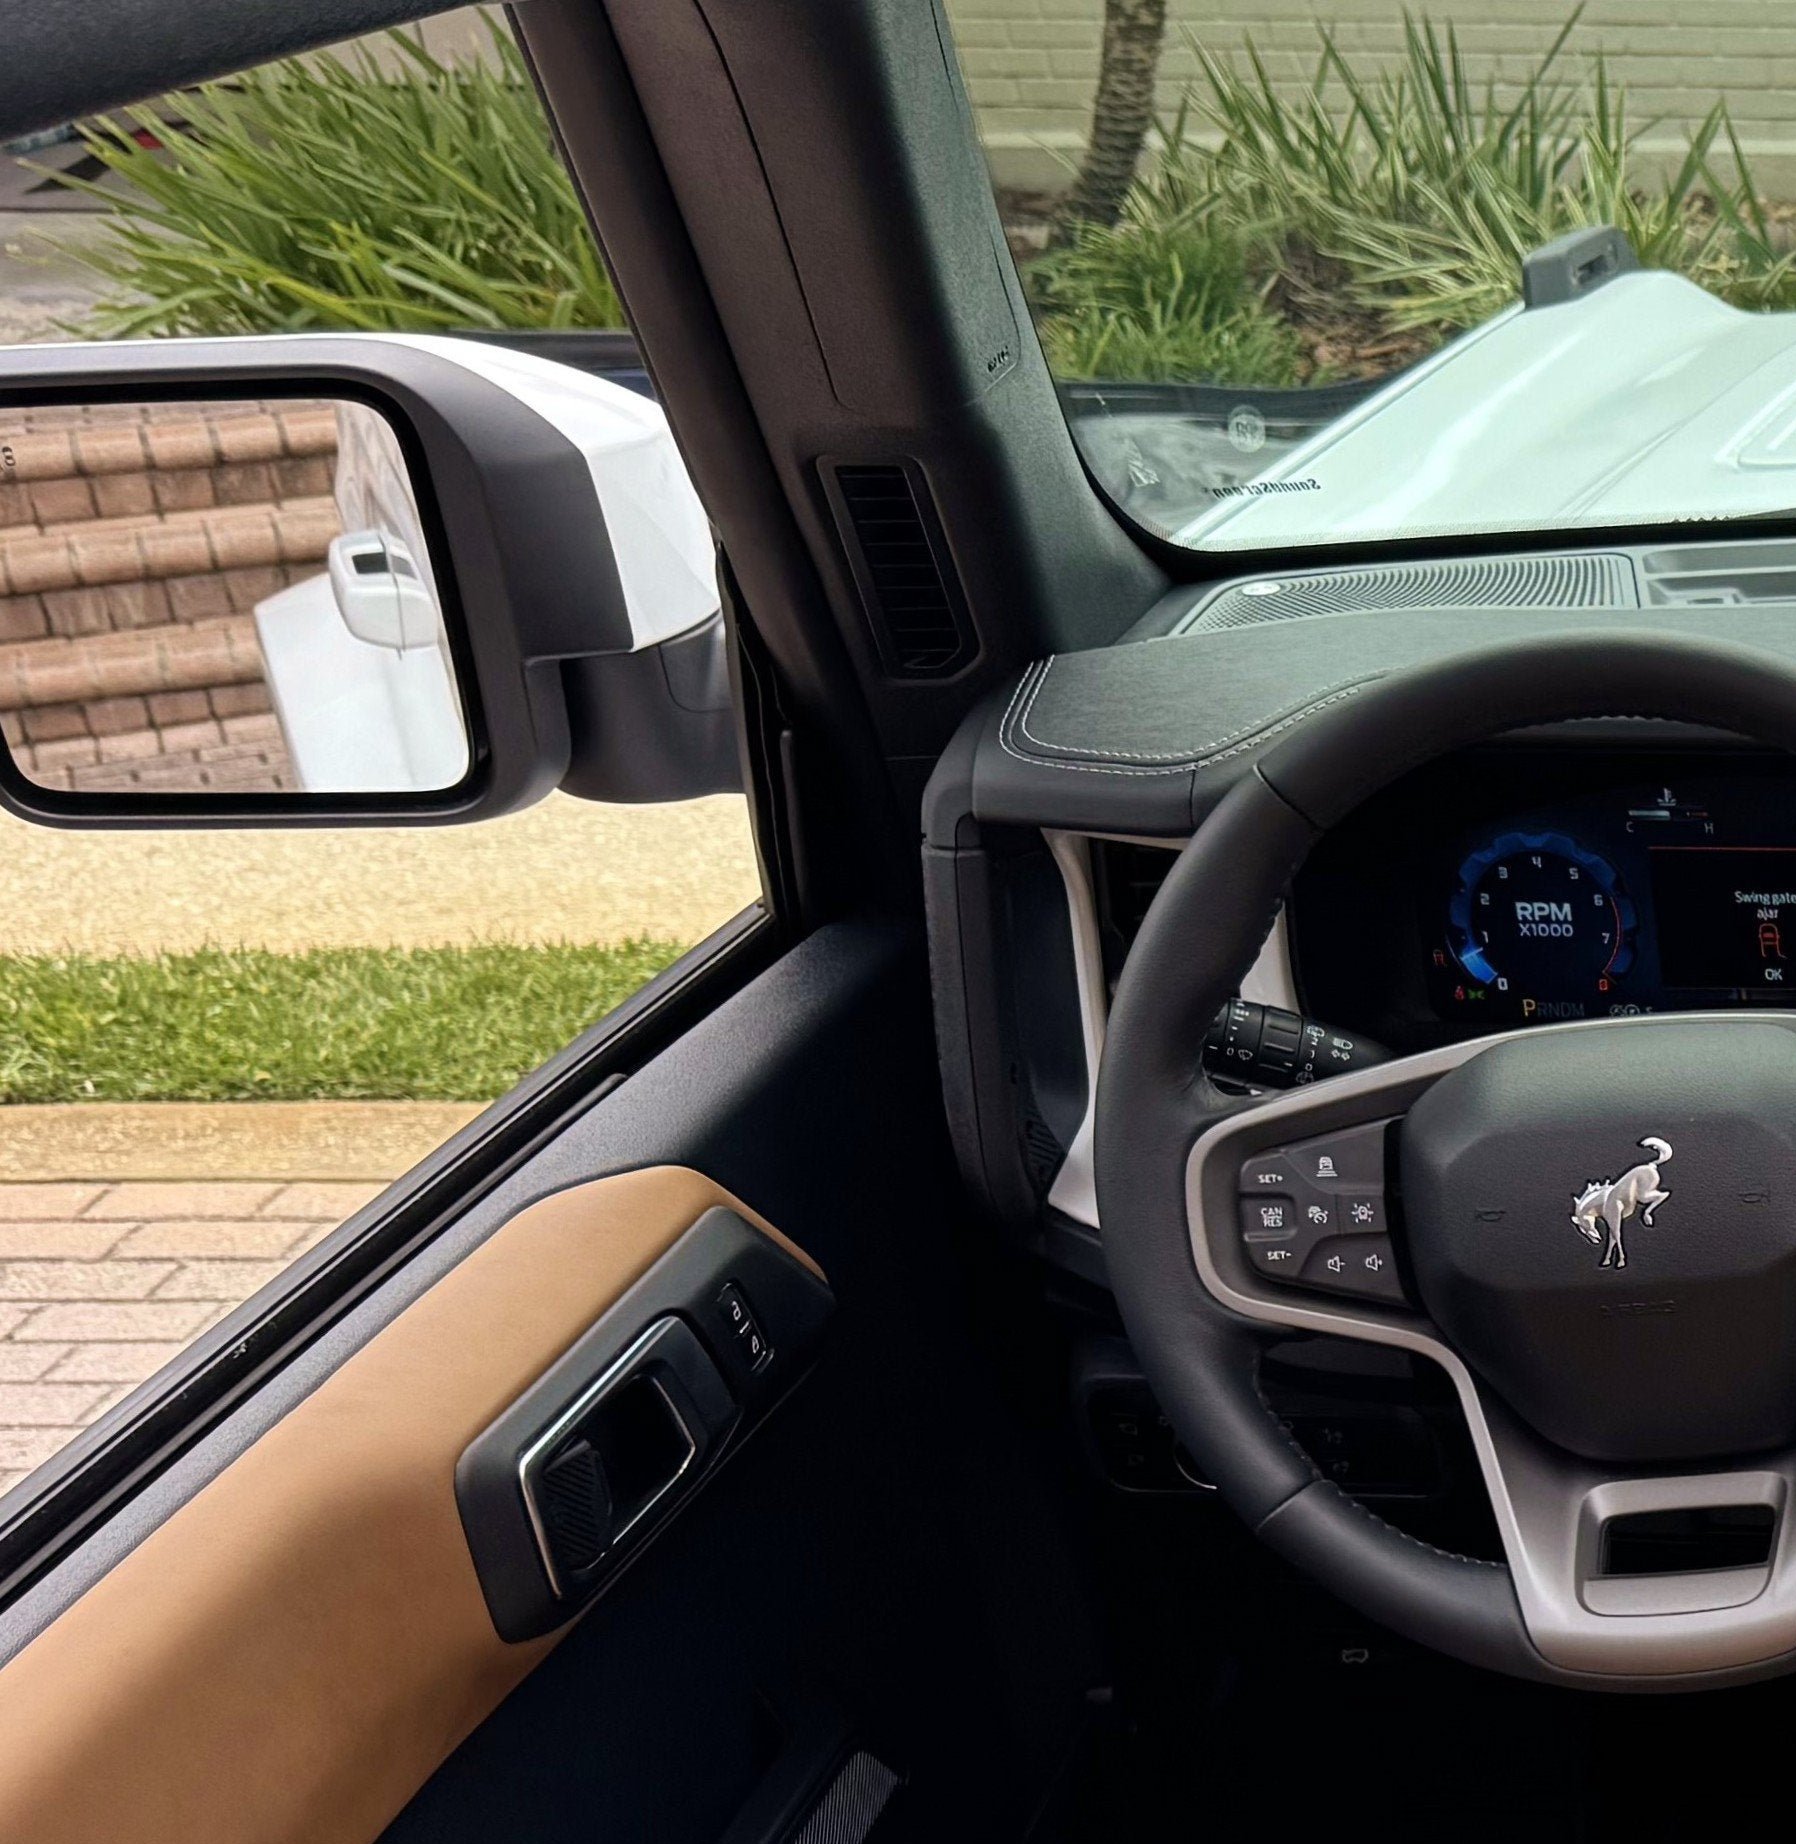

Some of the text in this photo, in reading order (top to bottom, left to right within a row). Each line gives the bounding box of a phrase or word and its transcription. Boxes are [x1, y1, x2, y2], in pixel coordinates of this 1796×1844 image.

[1735, 891, 1770, 905] Swing
[1515, 902, 1573, 922] RPM
[1520, 923, 1574, 938] X1000
[1764, 969, 1784, 981] OK
